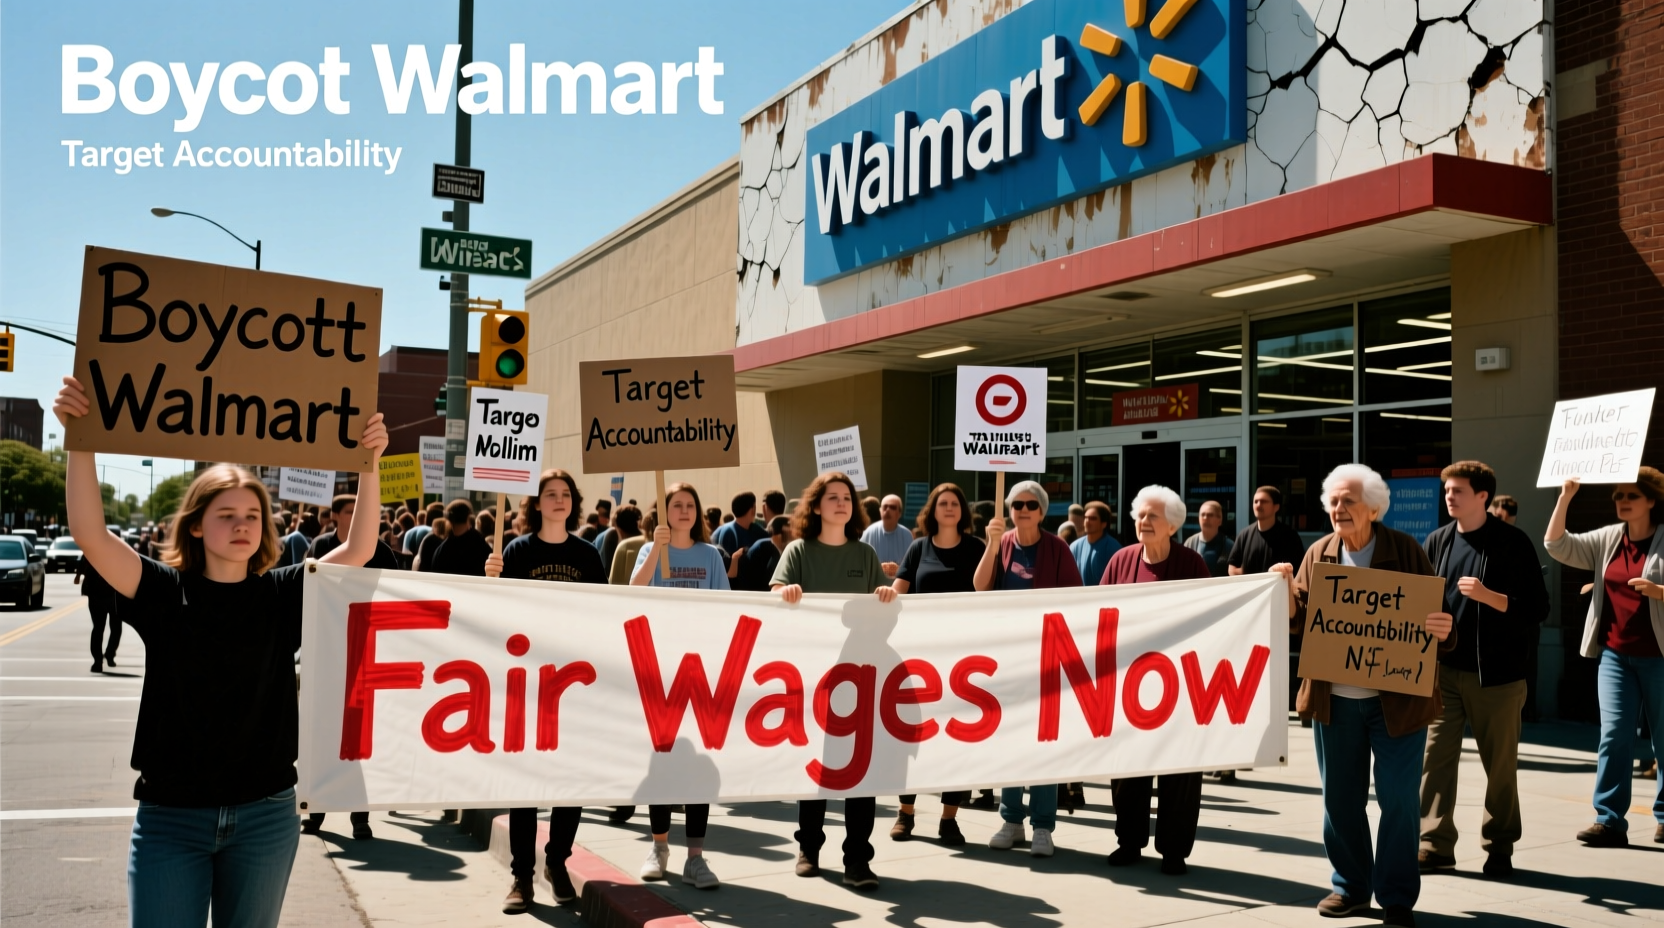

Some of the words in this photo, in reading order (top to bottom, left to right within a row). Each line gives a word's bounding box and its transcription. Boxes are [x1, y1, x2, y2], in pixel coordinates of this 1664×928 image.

[812, 35, 1066, 235] Walmart
[98, 262, 367, 372] Boycott
[89, 359, 360, 449] Walmart
[585, 417, 736, 452] Accountability
[601, 368, 705, 412] Target
[1324, 575, 1406, 615] Target
[340, 600, 597, 760] Fair
[624, 614, 1001, 791] Wages
[1038, 607, 1270, 742] Now
